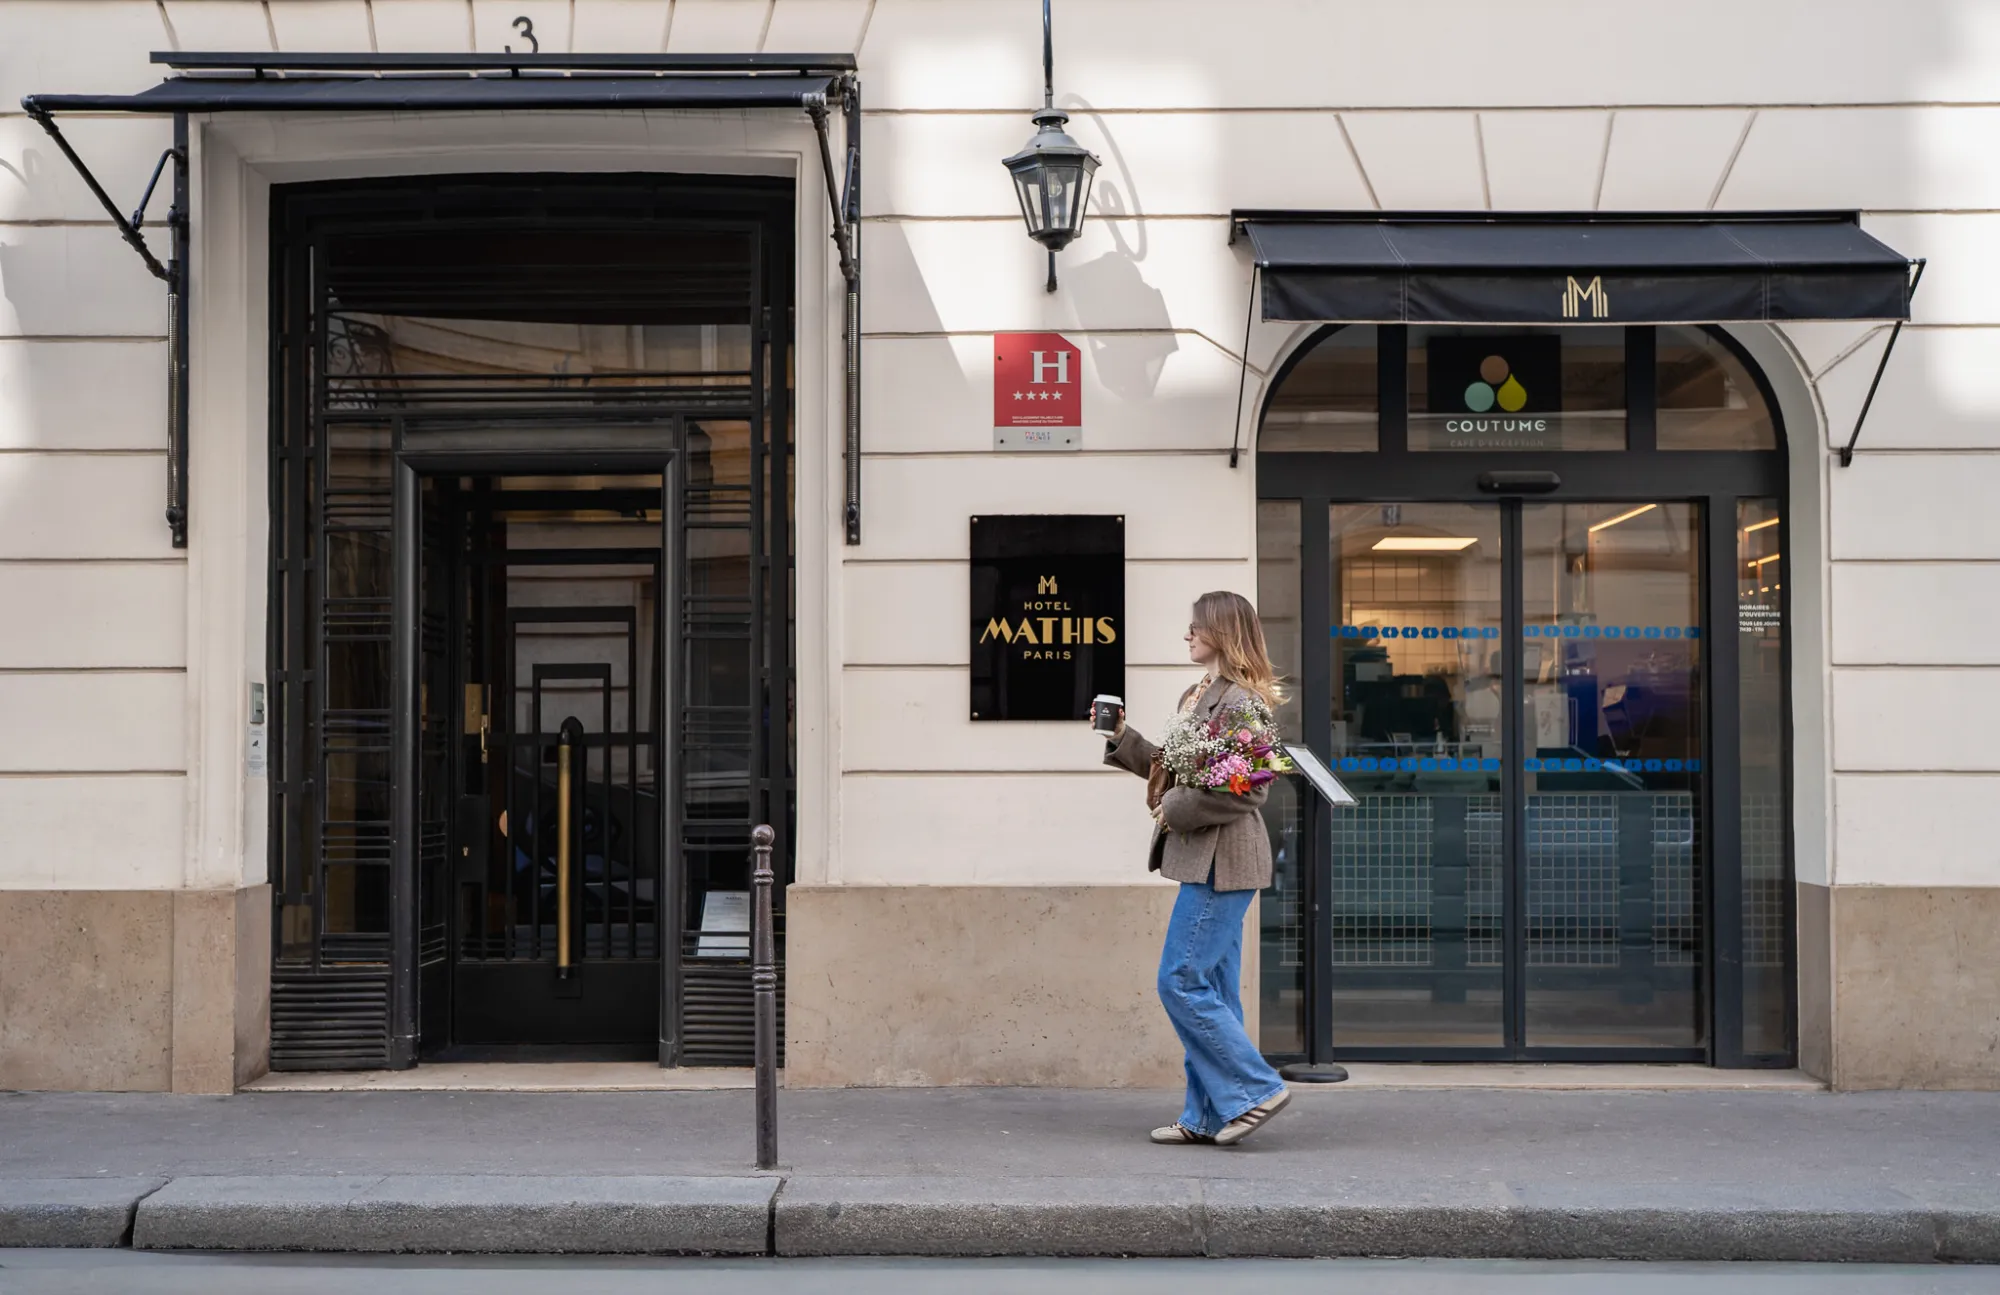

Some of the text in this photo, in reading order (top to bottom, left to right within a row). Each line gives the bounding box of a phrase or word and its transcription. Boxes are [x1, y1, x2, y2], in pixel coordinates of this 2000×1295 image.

[504, 16, 538, 54] 3
[1029, 350, 1072, 384] H
[1446, 420, 1546, 432] COUTUME
[1024, 602, 1071, 610] HOTEL
[980, 616, 1116, 644] MATHIS
[1024, 651, 1071, 659] PARIS
